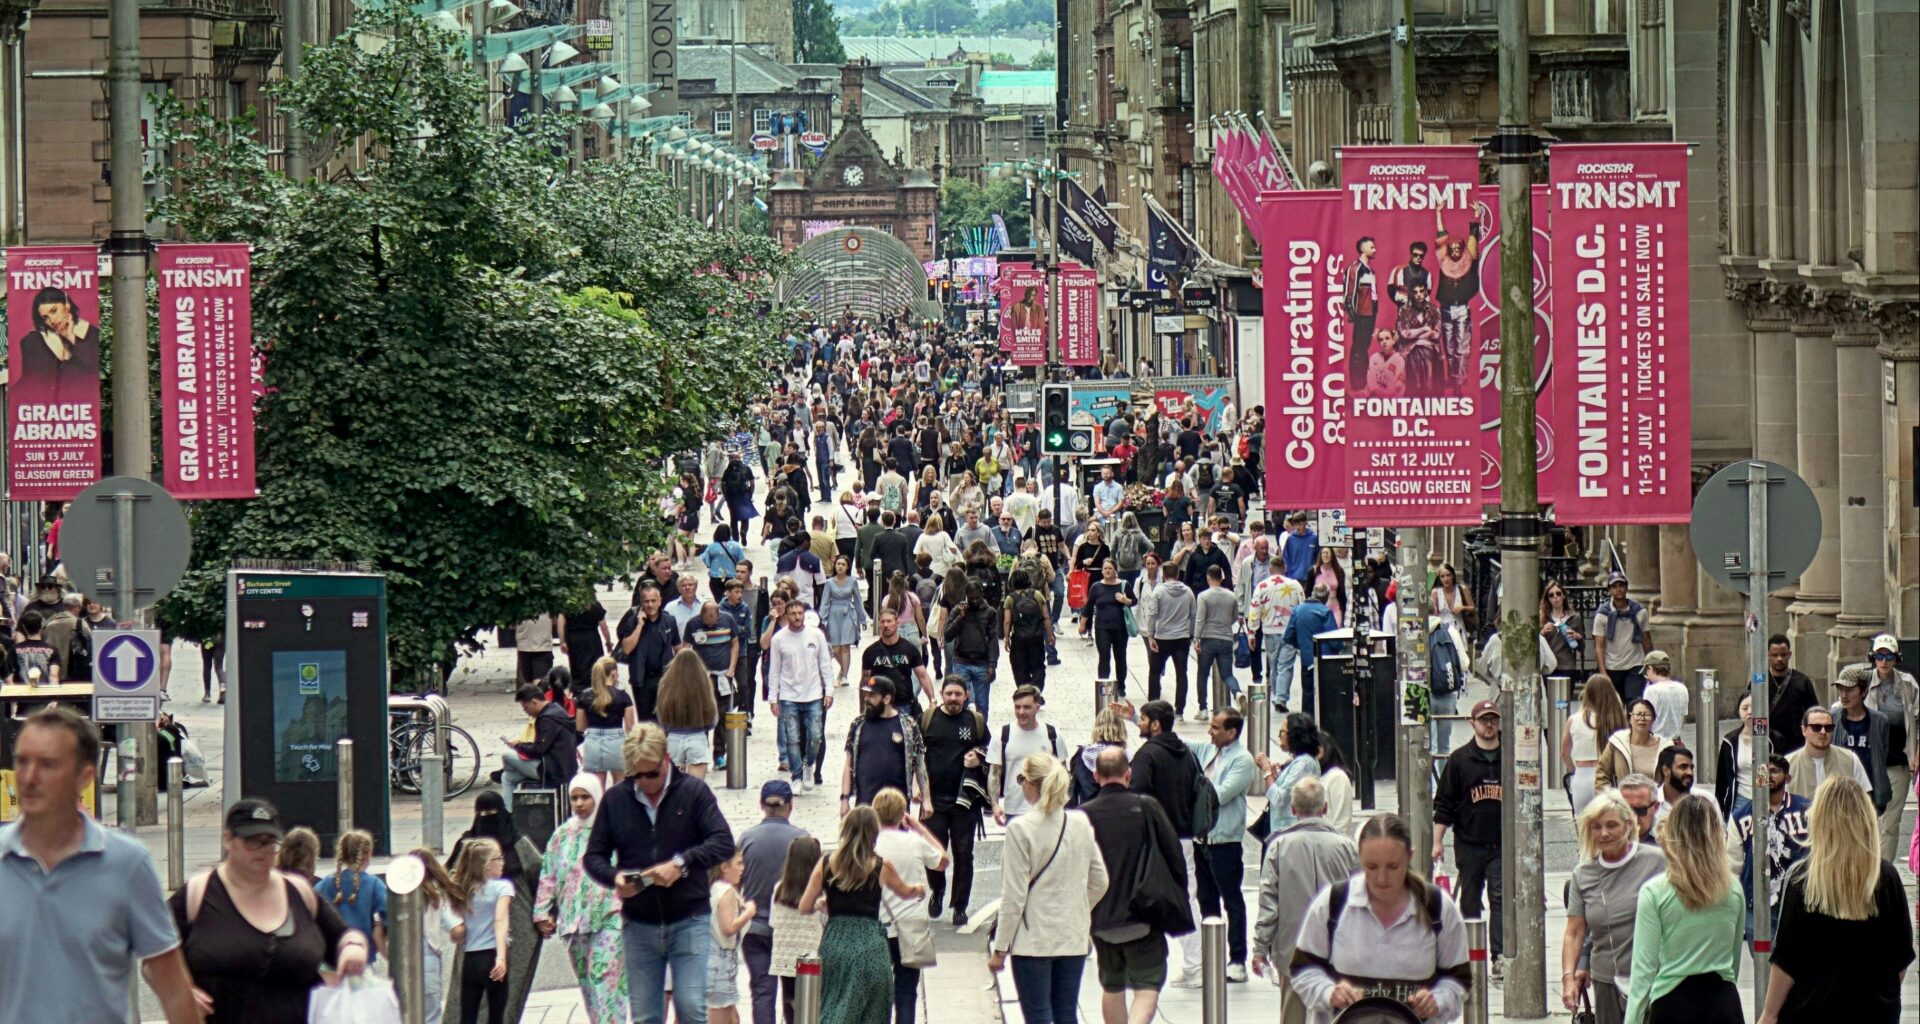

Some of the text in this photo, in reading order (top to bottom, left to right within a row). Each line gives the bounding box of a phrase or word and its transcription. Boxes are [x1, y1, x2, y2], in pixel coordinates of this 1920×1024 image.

[602, 20, 612, 28] LET
[1369, 165, 1426, 175] ROCKSTAR
[1577, 163, 1634, 174] ROCKSTAR
[1348, 183, 1472, 210] TRNSMT
[1556, 181, 1680, 209] TRNSMT
[24, 259, 63, 267] ROCKSTAR
[175, 257, 214, 265] ROCKSTAR
[11, 270, 94, 290] TRNSMT
[162, 269, 245, 288] TRNSMT
[1012, 279, 1043, 287] TRNSMT
[1065, 279, 1096, 287] TRNSMT
[1068, 324, 1078, 359] MYLES
[1322, 254, 1345, 444] 850 years
[1283, 240, 1321, 469] Celebrating
[1576, 224, 1608, 497] FONTAINES D.C.
[1635, 225, 1652, 495] 11-13 JULY TICKETS ON SALE NOW
[176, 296, 199, 481] GRACIE ABRAMS
[214, 298, 229, 479] 11-13 JULY TICKETS ON SALE NOW
[18, 404, 92, 421] GRACIE
[1353, 397, 1474, 416] FONTAINES
[14, 423, 97, 440] ABRAMS
[1392, 419, 1435, 437] D.C.
[25, 452, 84, 461] SUN 13 JULY
[1371, 453, 1455, 466] SAT 12 JULY
[15, 470, 94, 479] GLASGOW GREEN
[1353, 480, 1471, 494] GLASGOW GREEN
